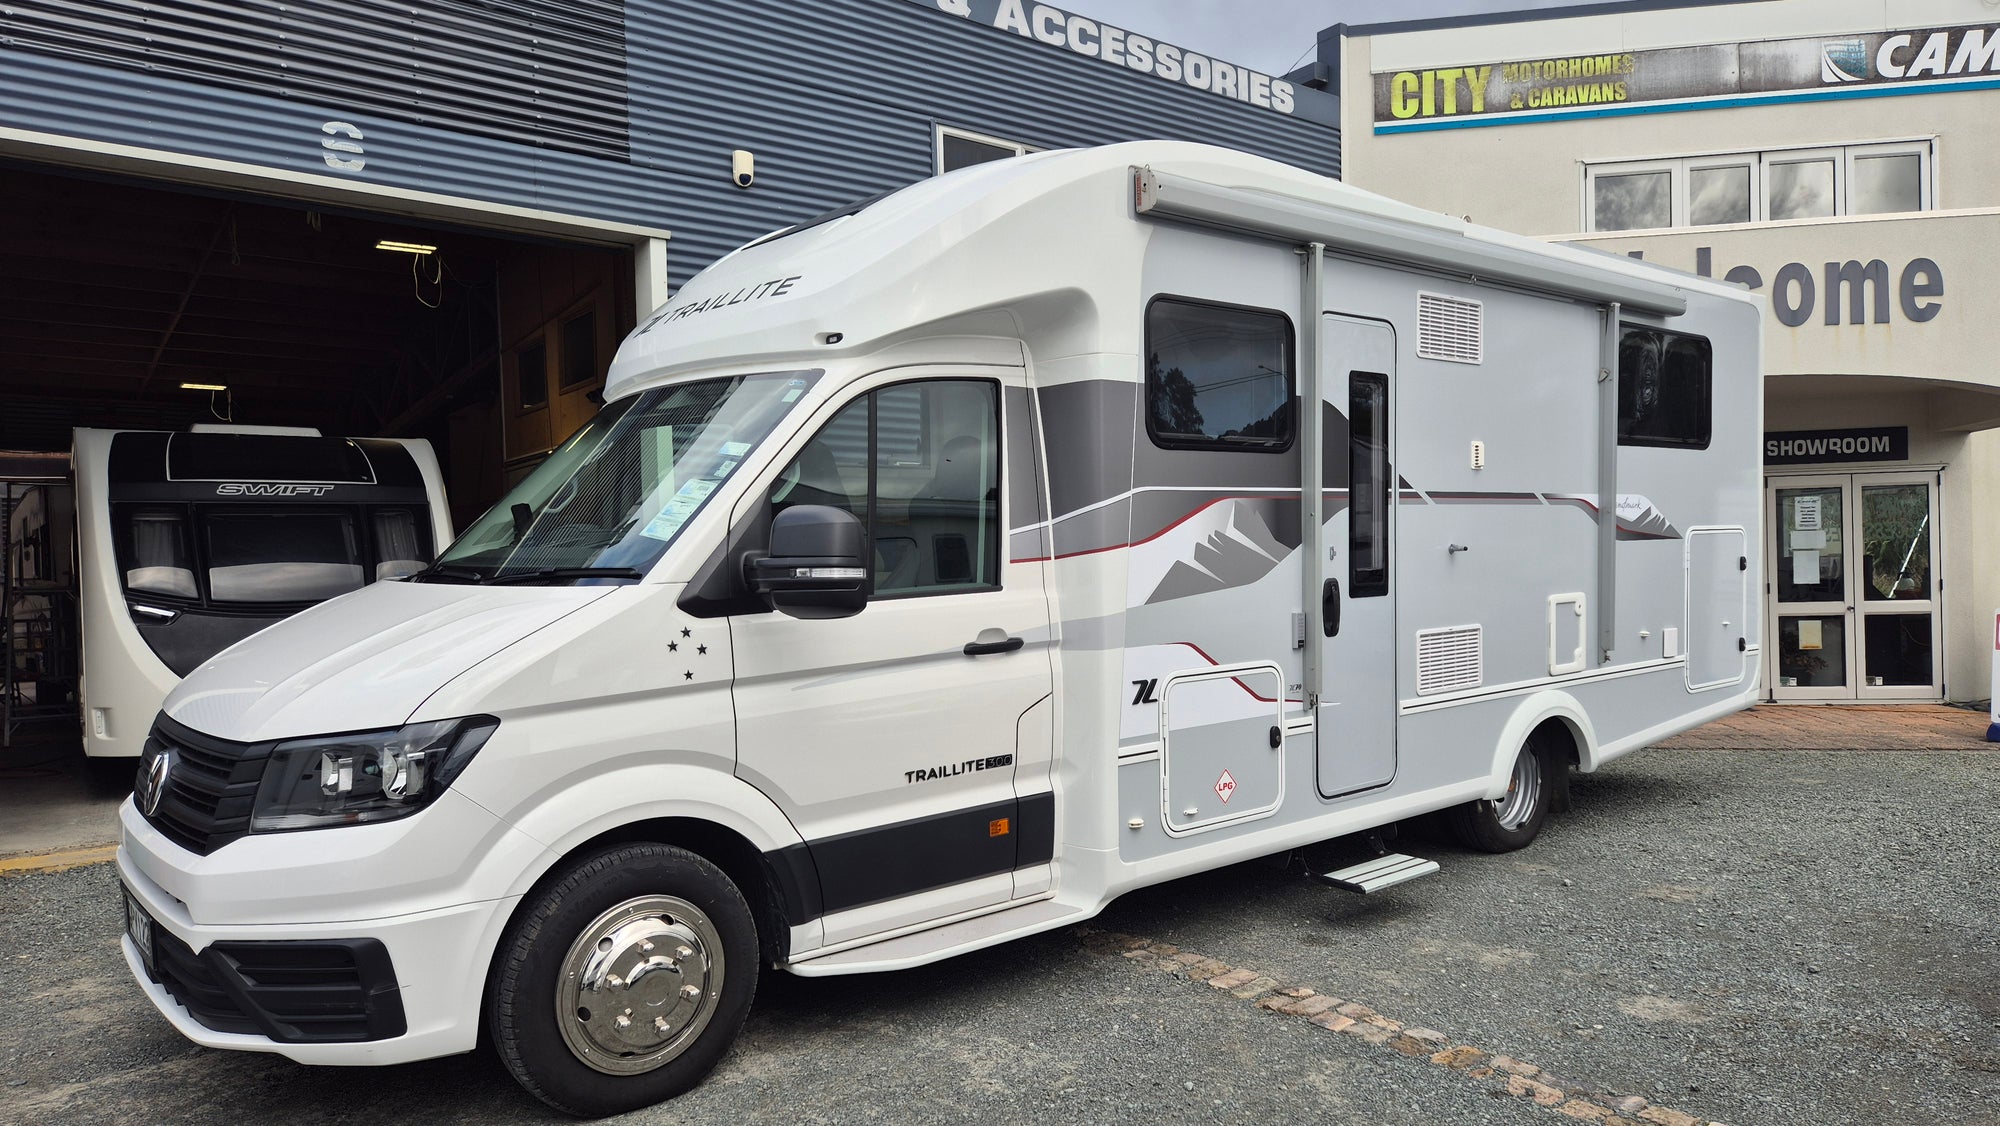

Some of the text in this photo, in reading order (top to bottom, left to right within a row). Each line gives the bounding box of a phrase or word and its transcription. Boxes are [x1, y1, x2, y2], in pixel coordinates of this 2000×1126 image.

[993, 0, 1295, 114] ACCESSORIES
[1503, 54, 1635, 83] MOTORHOMES
[1391, 66, 1491, 119] CITY
[1510, 81, 1627, 109] & CARAVANS
[664, 275, 802, 325] TRAILLITE
[1767, 436, 1890, 457] SHOWROOM
[216, 483, 335, 496] SWIFT
[1217, 781, 1234, 793] LPG
